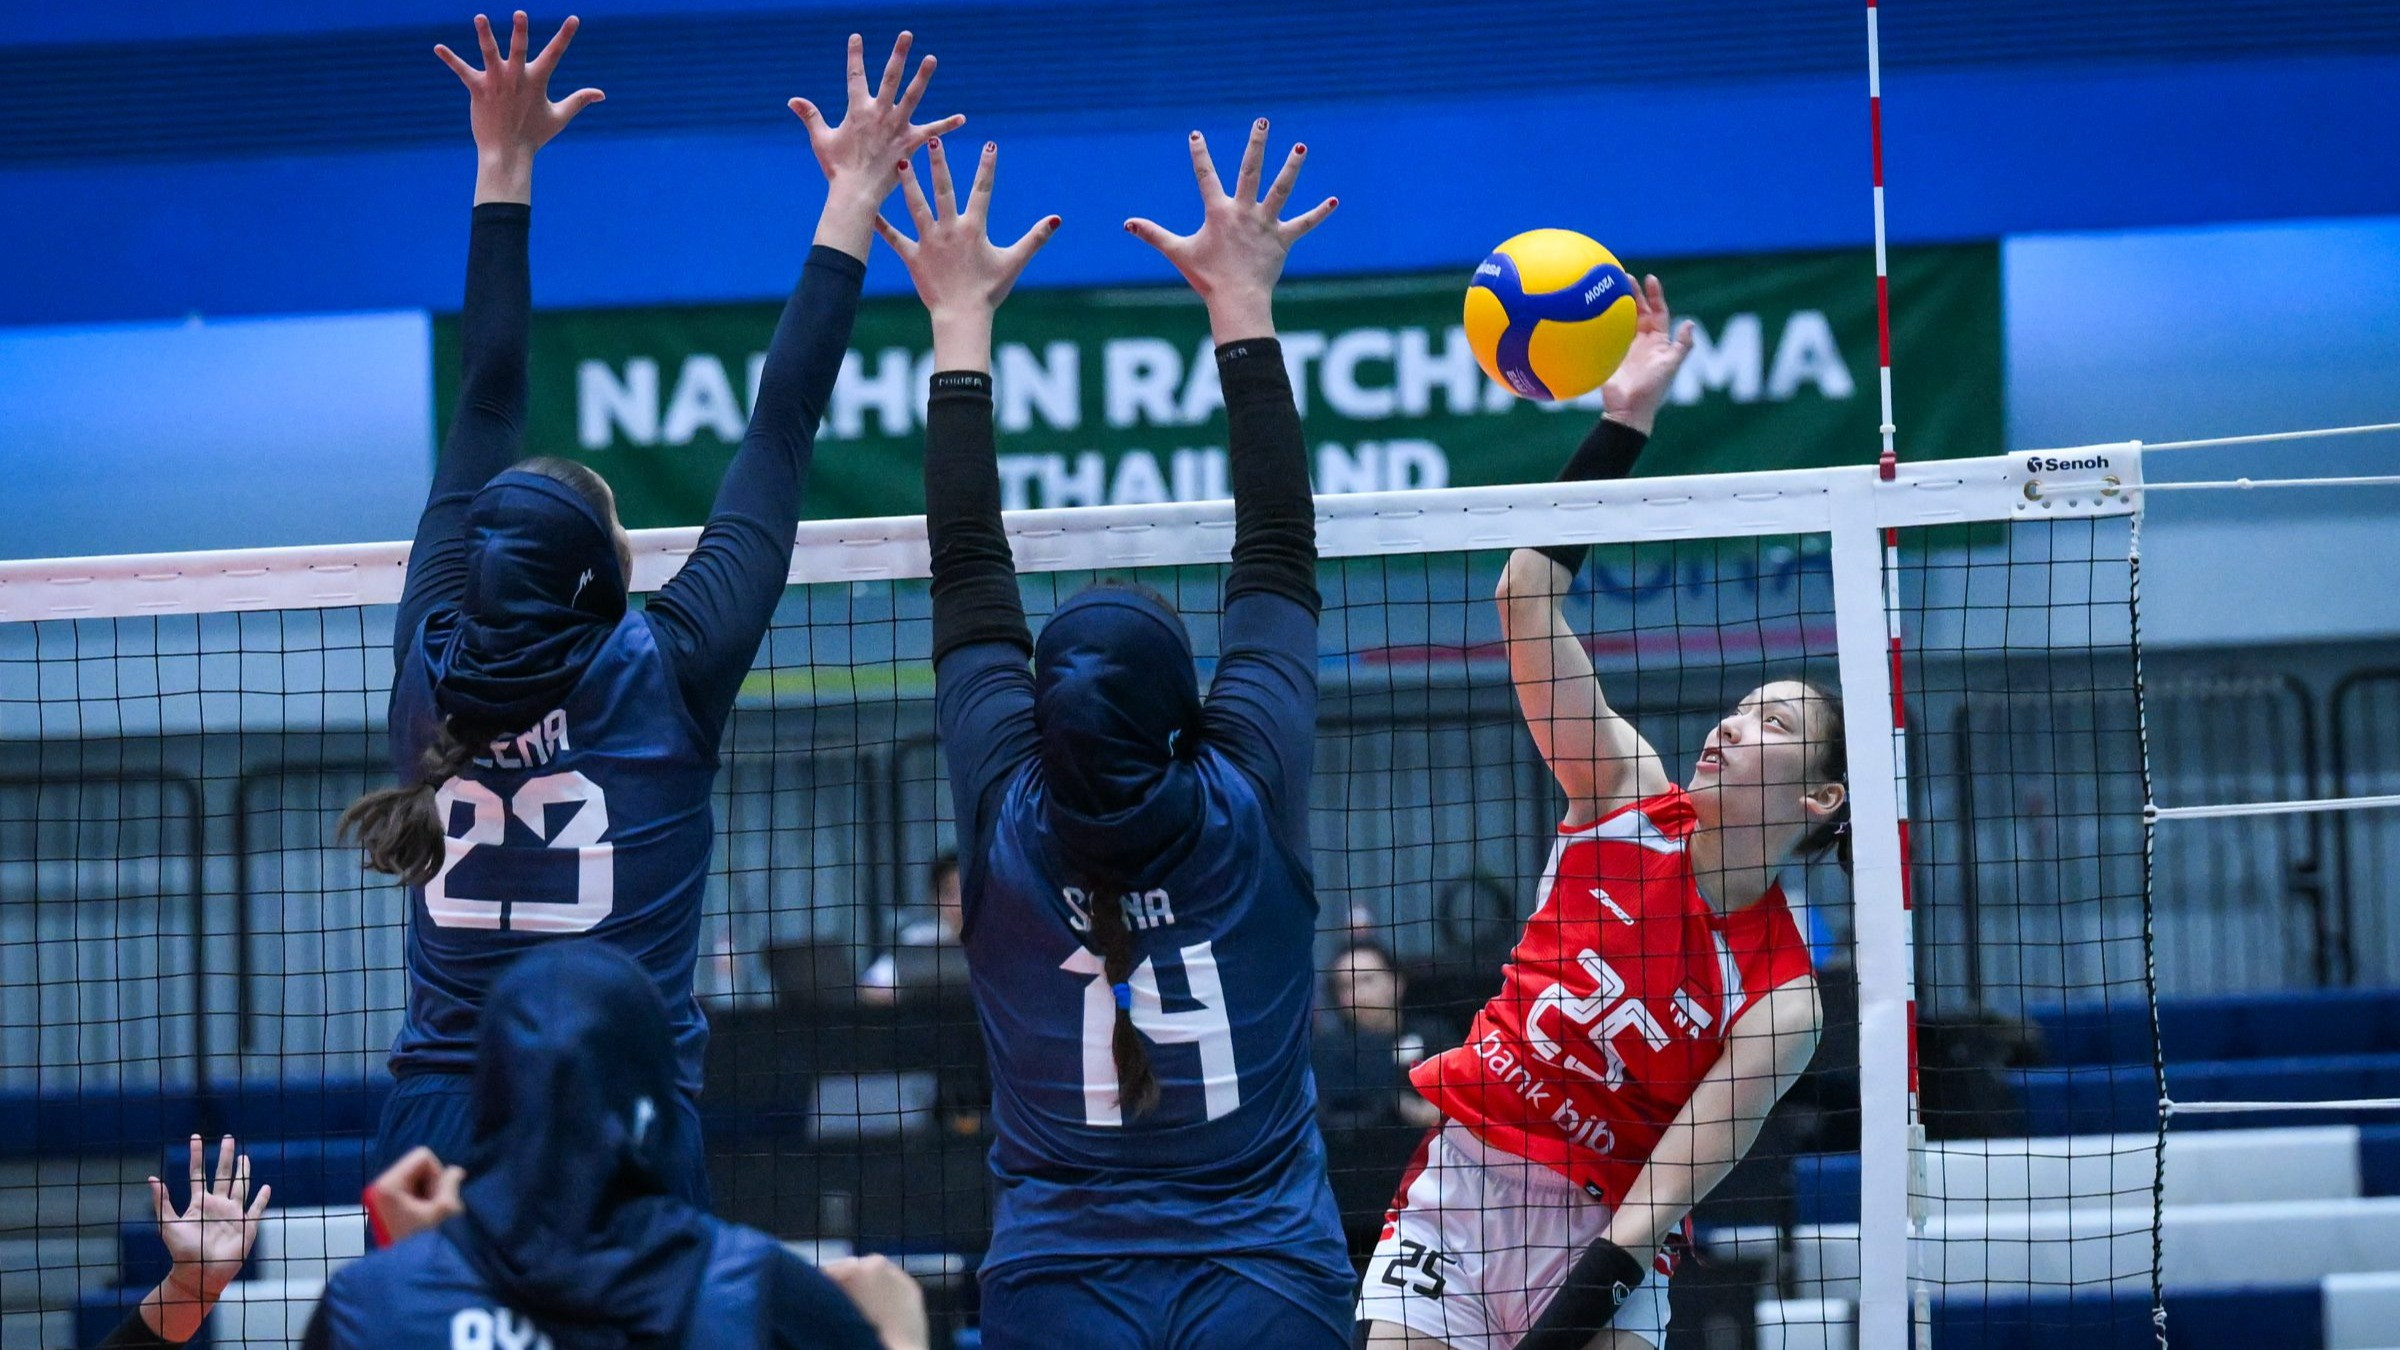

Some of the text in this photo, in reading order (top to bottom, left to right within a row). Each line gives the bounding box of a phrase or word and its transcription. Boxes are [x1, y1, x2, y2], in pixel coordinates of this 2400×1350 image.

[1584, 274, 1615, 305] V200W
[575, 342, 1081, 450] NAHN
[997, 436, 1450, 512] THAILND
[2045, 455, 2109, 471] Senoh
[424, 770, 614, 933] 23
[1063, 887, 1175, 931] SNA
[1059, 940, 1240, 1126] 14
[1526, 948, 1672, 1093] 25
[1474, 1029, 1616, 1155] bank bjb
[1381, 1239, 1457, 1300] 25
